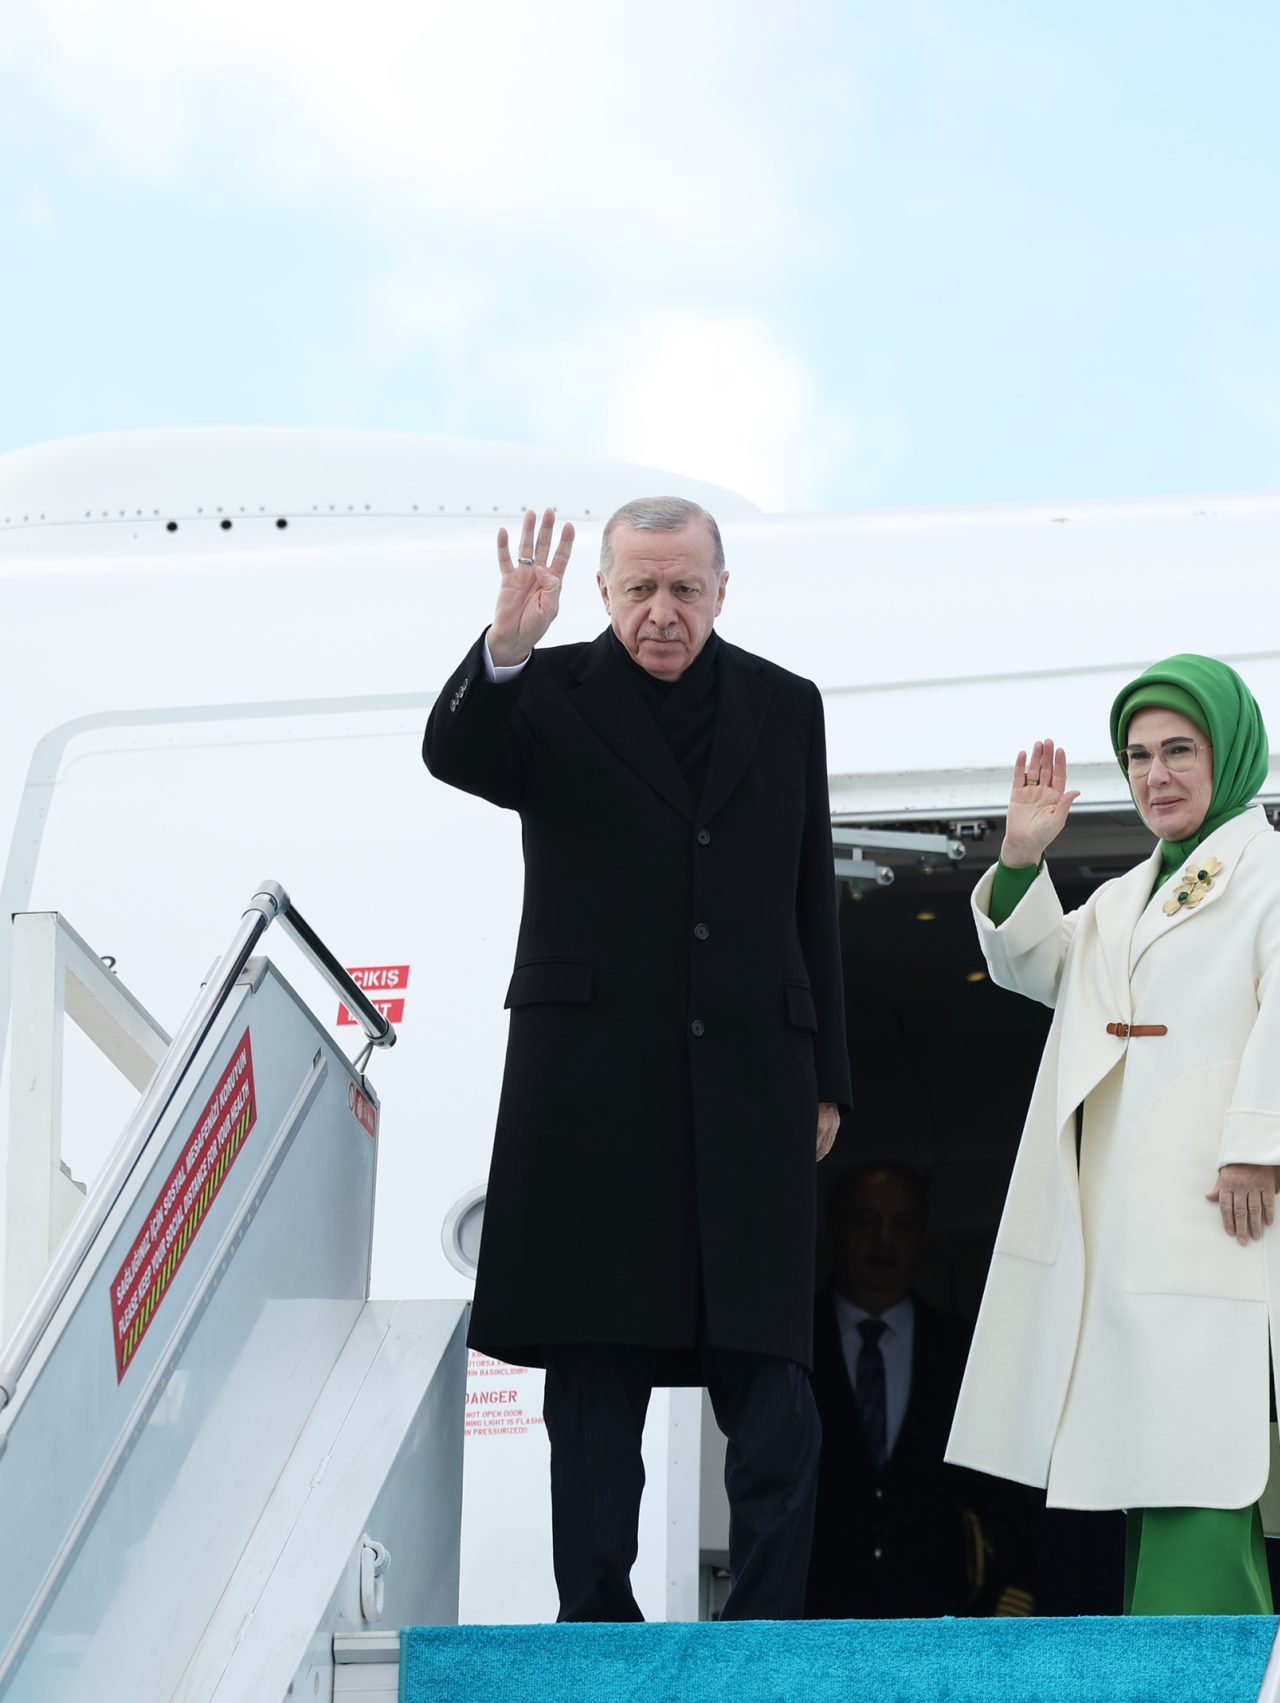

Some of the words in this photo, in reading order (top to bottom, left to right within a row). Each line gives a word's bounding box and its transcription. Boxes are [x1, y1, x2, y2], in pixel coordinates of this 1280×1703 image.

[118, 1290, 139, 1339] PLEASE
[137, 1265, 152, 1302] KEEP
[151, 1237, 166, 1274] YOUR
[166, 1204, 184, 1249] SOCIAL
[184, 1157, 207, 1214] DISTANCE
[207, 1139, 218, 1170] FOR
[217, 1113, 231, 1149] YOUR
[230, 1078, 249, 1125] HEALTH
[164, 1165, 186, 1216] SOSYAL
[219, 1048, 247, 1110] KORUYUN
